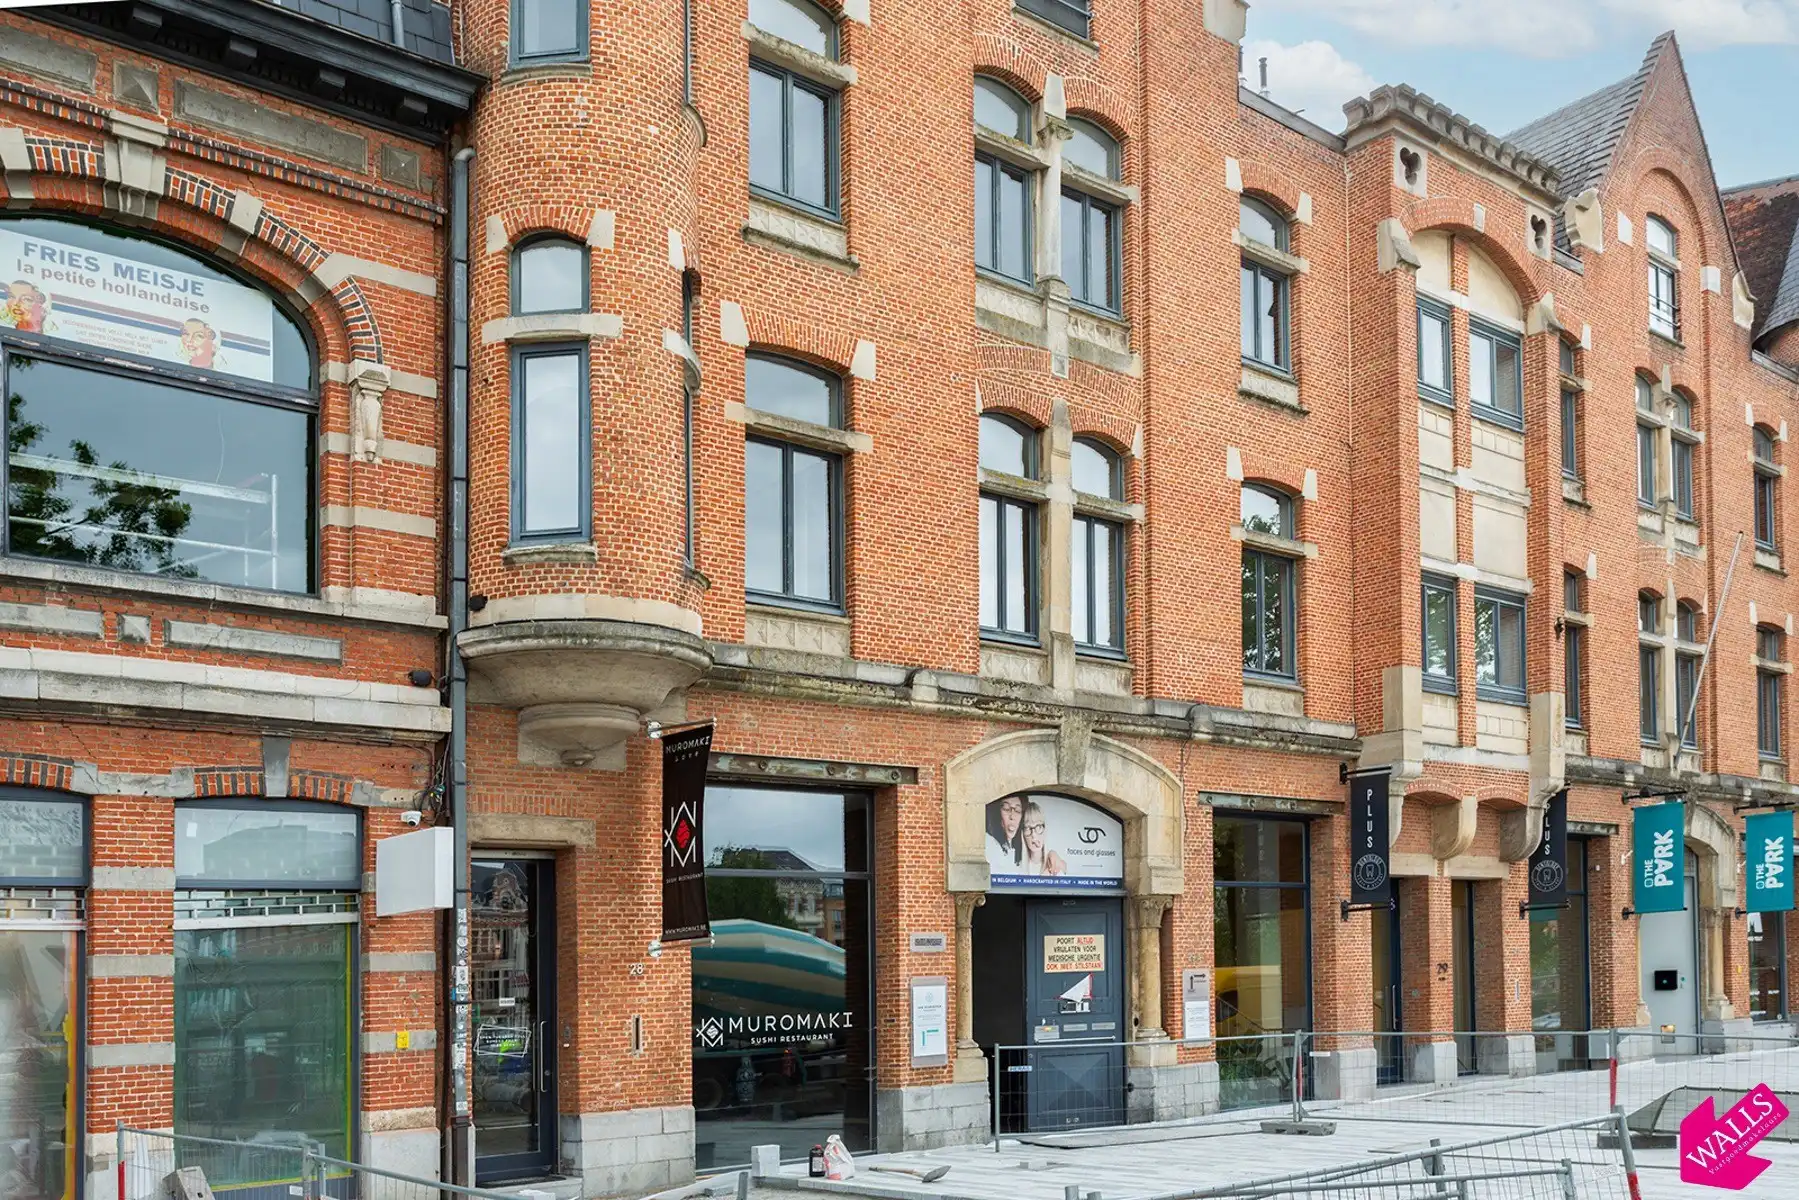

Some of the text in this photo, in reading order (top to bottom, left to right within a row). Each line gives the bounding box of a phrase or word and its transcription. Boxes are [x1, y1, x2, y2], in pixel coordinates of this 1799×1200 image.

[23, 241, 205, 297] FRIES MEISJE
[16, 258, 210, 314] la petite hollandaise
[666, 736, 710, 754] MUROMAKI
[1067, 848, 1116, 857] faces and glasses
[1654, 829, 1674, 887] PARK
[1644, 859, 1654, 878] THE
[1765, 836, 1785, 889] PARK
[1755, 863, 1765, 881] THE
[1048, 954, 1075, 962] MEDISCHE
[630, 963, 643, 975] 28
[729, 1012, 853, 1034] MUROMAKI
[750, 1033, 833, 1045] SUSHI RESTAURANT
